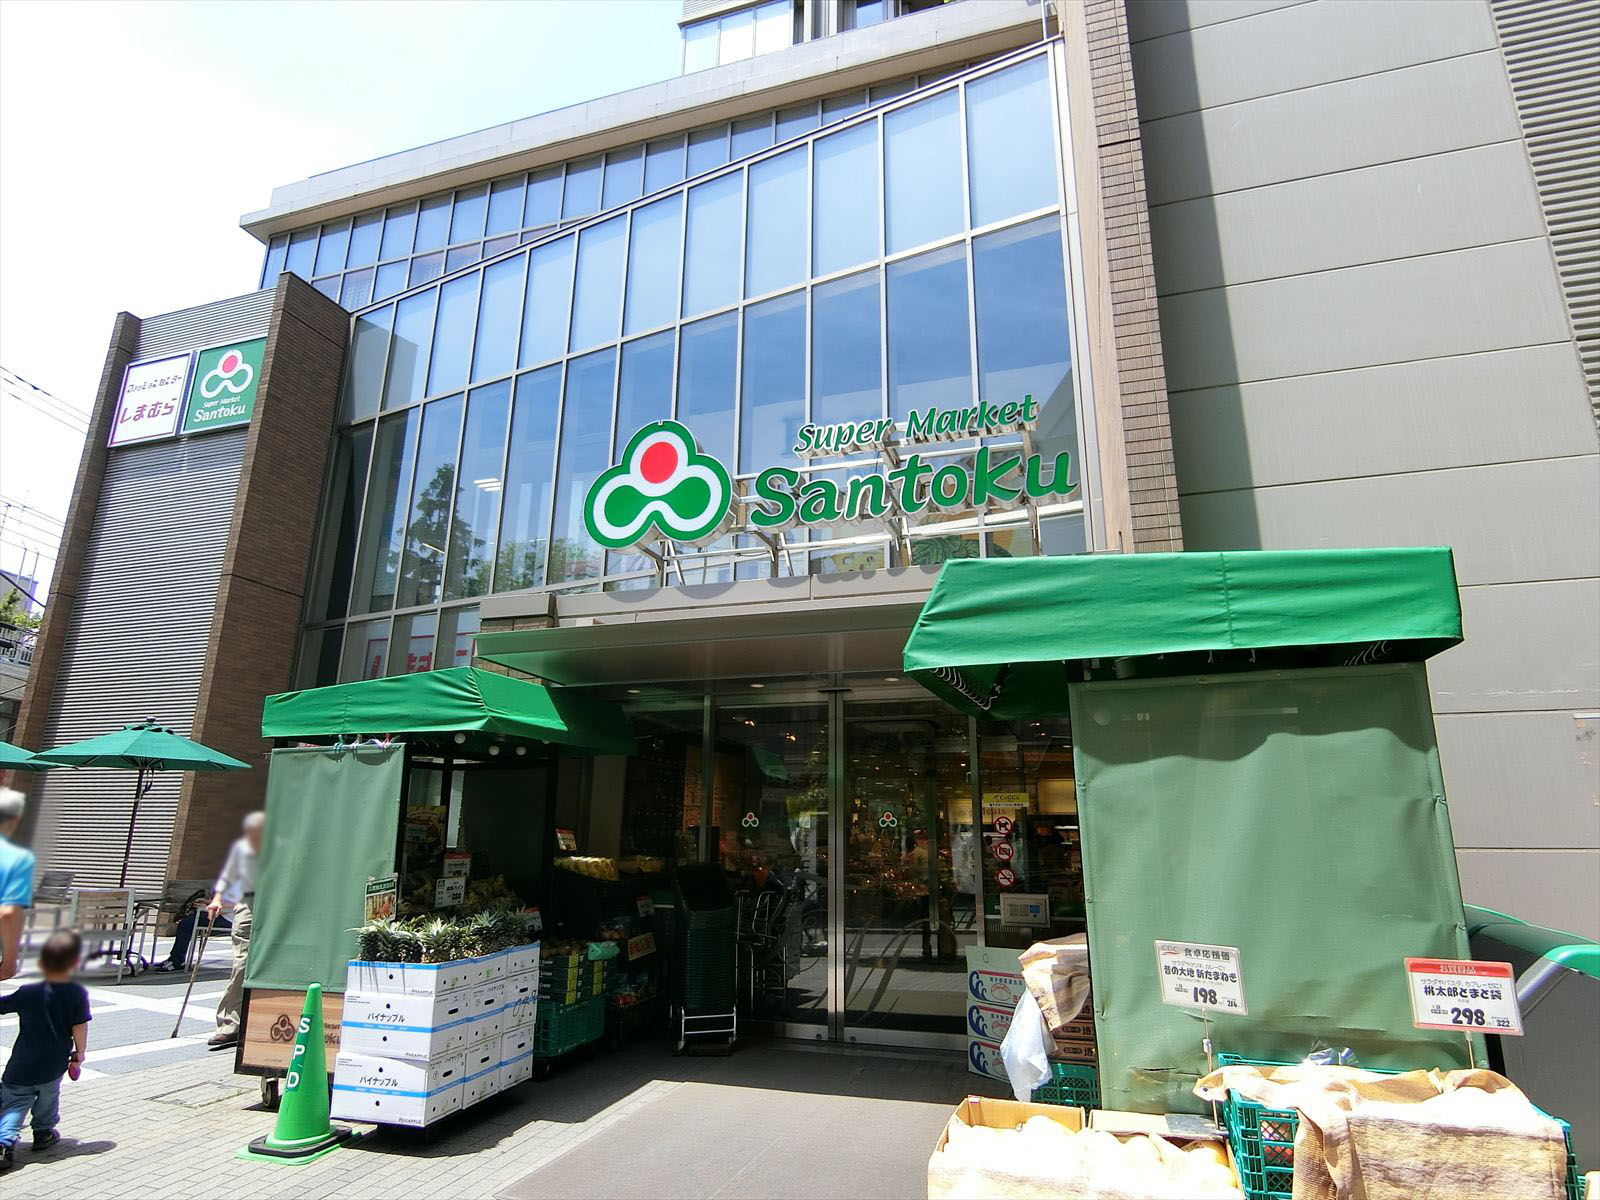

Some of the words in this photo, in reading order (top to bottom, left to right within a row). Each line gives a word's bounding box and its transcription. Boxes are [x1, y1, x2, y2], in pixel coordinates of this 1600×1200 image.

[119, 397, 178, 424] しまむら
[202, 400, 220, 409] Super
[220, 395, 241, 404] Market
[193, 404, 247, 422] Santoku
[793, 417, 895, 455] Super
[905, 394, 1039, 438] Market
[750, 446, 1079, 532] Santoku
[1183, 947, 1231, 961] 食卓応援価
[1163, 964, 1195, 979] 昔の大地
[1196, 968, 1238, 984] 新たまねぎ
[1193, 986, 1218, 1006] 198
[1424, 984, 1503, 1001] 桃太郎とまと袋
[367, 1012, 406, 1023] パイナップル
[1451, 1007, 1487, 1026] 298
[1495, 1018, 1511, 1028] 322
[359, 1075, 399, 1088] パイナップル
